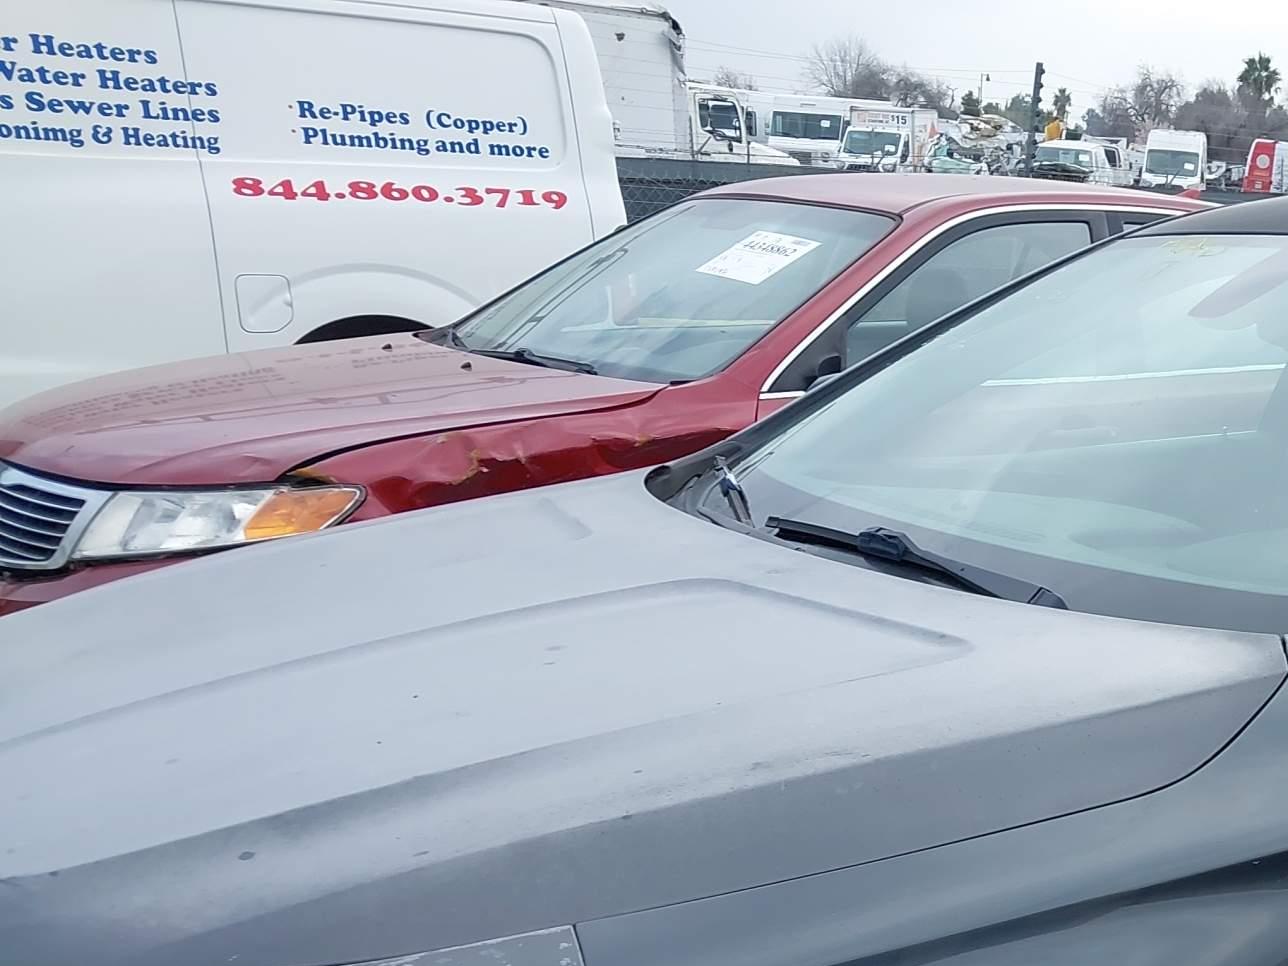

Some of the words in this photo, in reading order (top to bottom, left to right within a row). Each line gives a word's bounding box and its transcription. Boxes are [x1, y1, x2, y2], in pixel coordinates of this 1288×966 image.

[29, 33, 158, 64] Heaters
[96, 69, 218, 96] Heaters
[25, 91, 130, 118] Sewer
[139, 100, 221, 123] Lines
[296, 100, 410, 126] Re-Pipes
[426, 110, 528, 136] (Copper)
[92, 125, 113, 144] &
[121, 127, 221, 155] Heating
[301, 127, 430, 156] Plumbing
[435, 138, 482, 154] and
[488, 143, 551, 159] more
[232, 177, 568, 210] 844.860.3719
